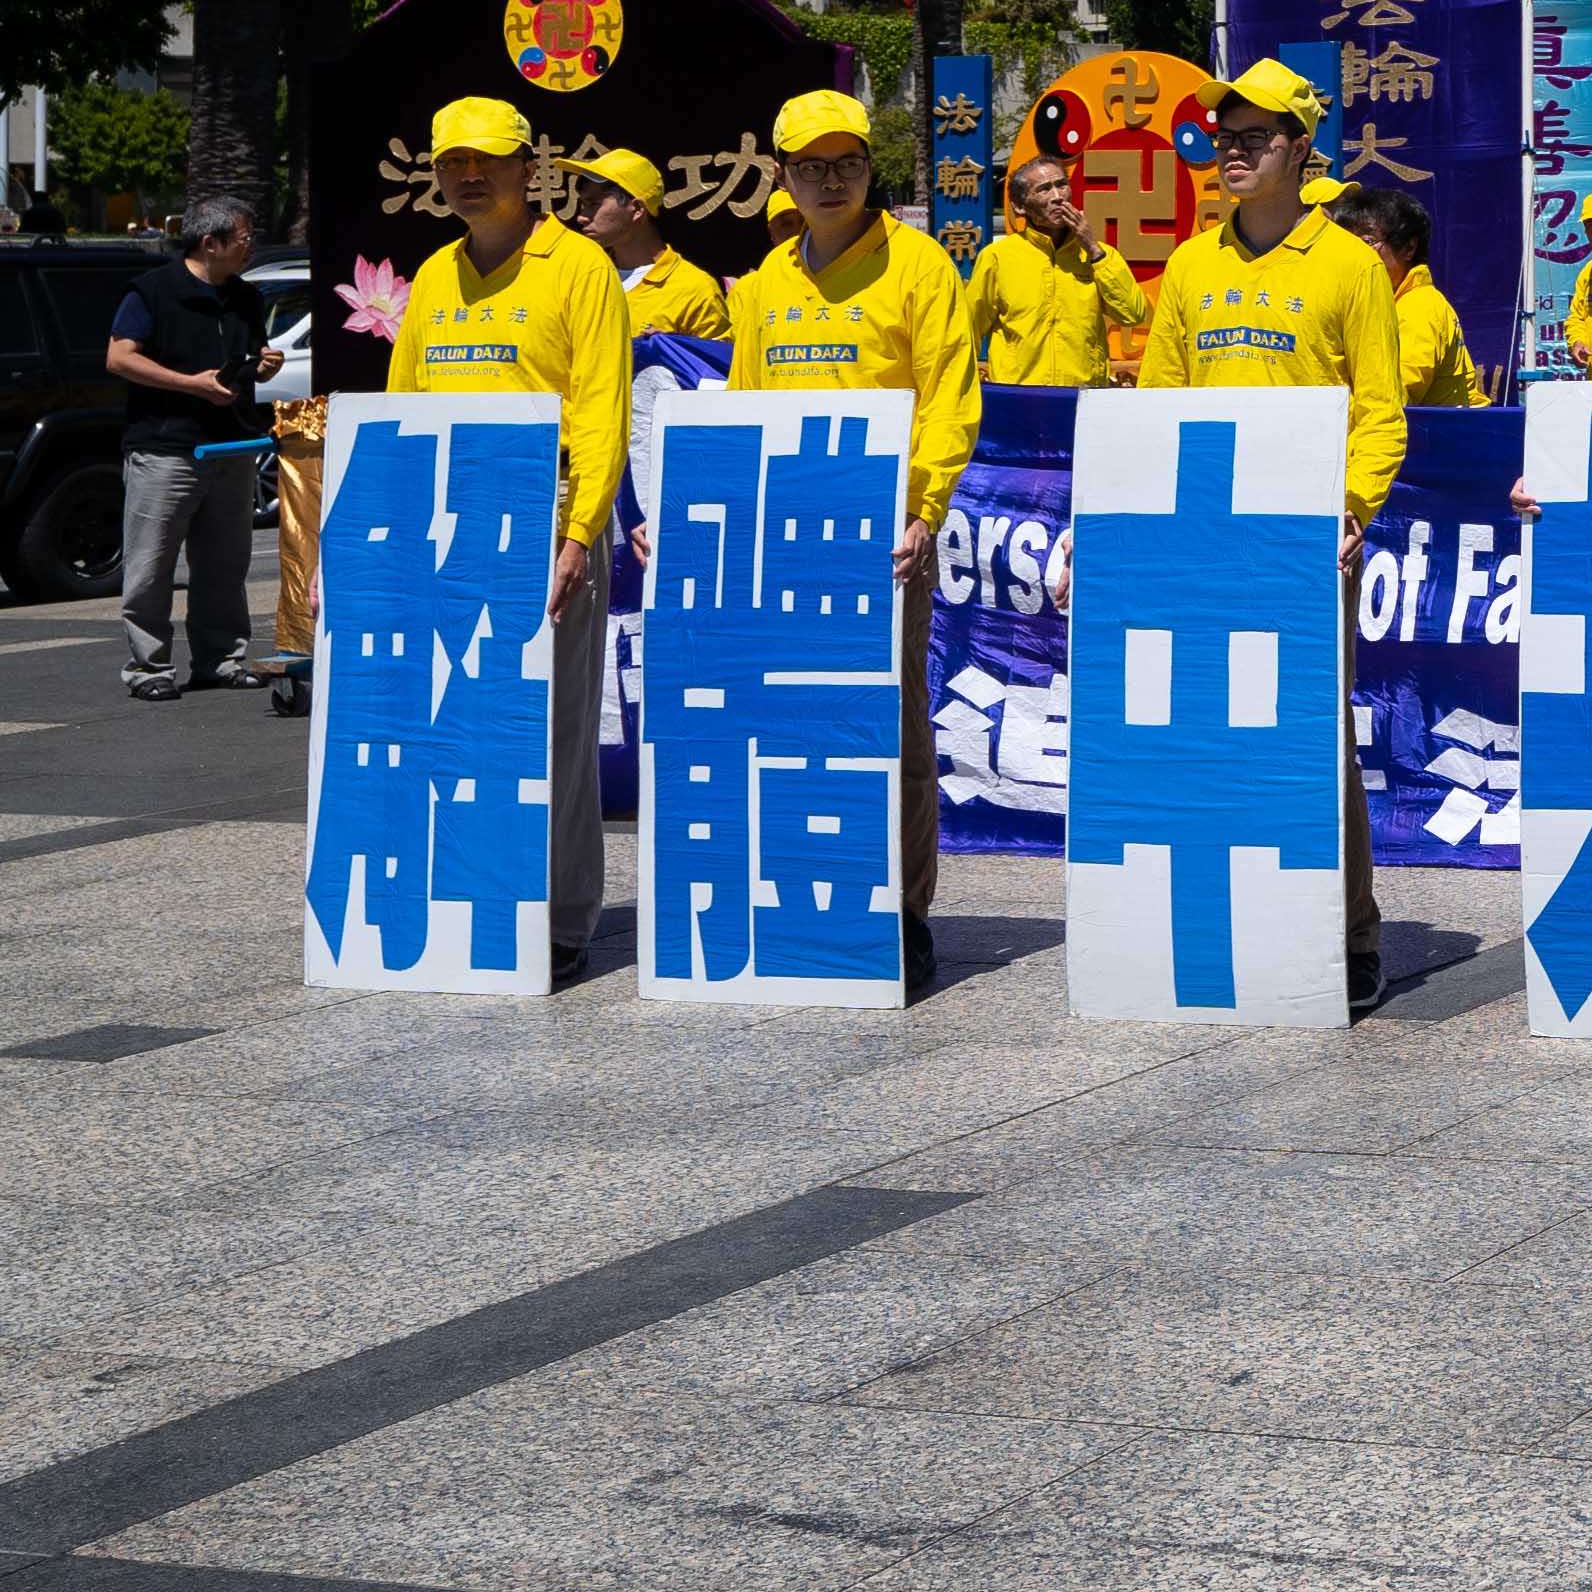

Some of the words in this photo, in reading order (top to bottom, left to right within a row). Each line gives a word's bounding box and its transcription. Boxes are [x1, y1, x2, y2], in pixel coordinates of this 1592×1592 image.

[430, 305, 528, 325] 法輪大法
[1199, 328, 1246, 347] FALUN
[1250, 330, 1289, 349] DAFA
[426, 346, 467, 361] FALUN
[473, 346, 513, 360] DAFA
[768, 347, 806, 361] LUN
[811, 347, 853, 359] DAFA
[1358, 520, 1430, 642] of
[306, 420, 559, 970] 解
[642, 416, 900, 981] 體
[1067, 421, 1338, 1008] 中
